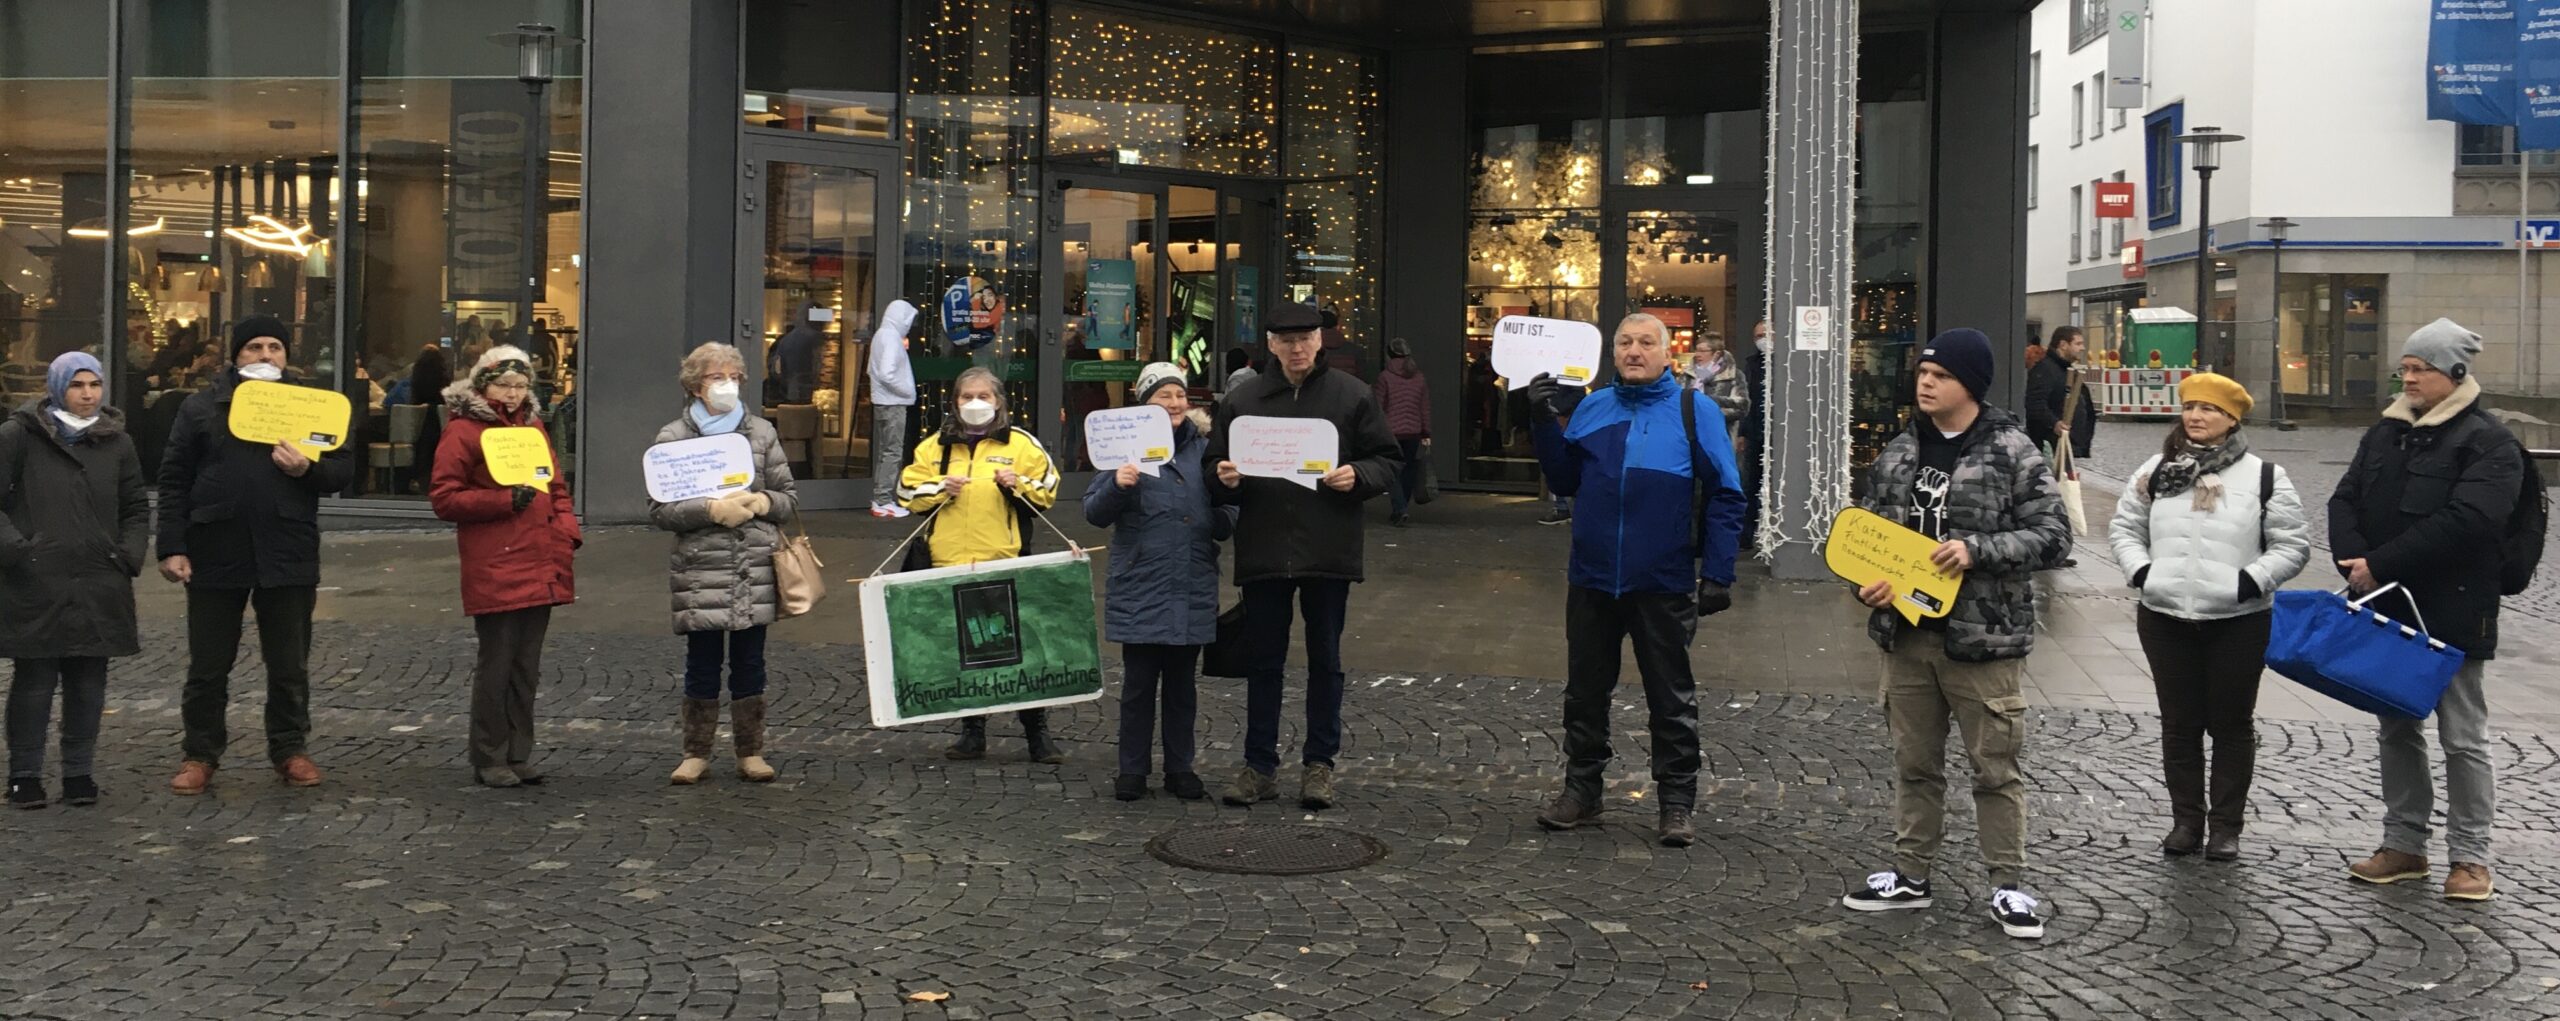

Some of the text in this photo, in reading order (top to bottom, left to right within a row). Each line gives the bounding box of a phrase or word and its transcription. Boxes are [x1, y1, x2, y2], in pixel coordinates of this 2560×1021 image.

[2101, 194, 2130, 204] WITT
[1503, 321, 1526, 335] MUT
[1007, 362, 1025, 371] noc
[1849, 514, 1890, 542] Katar
